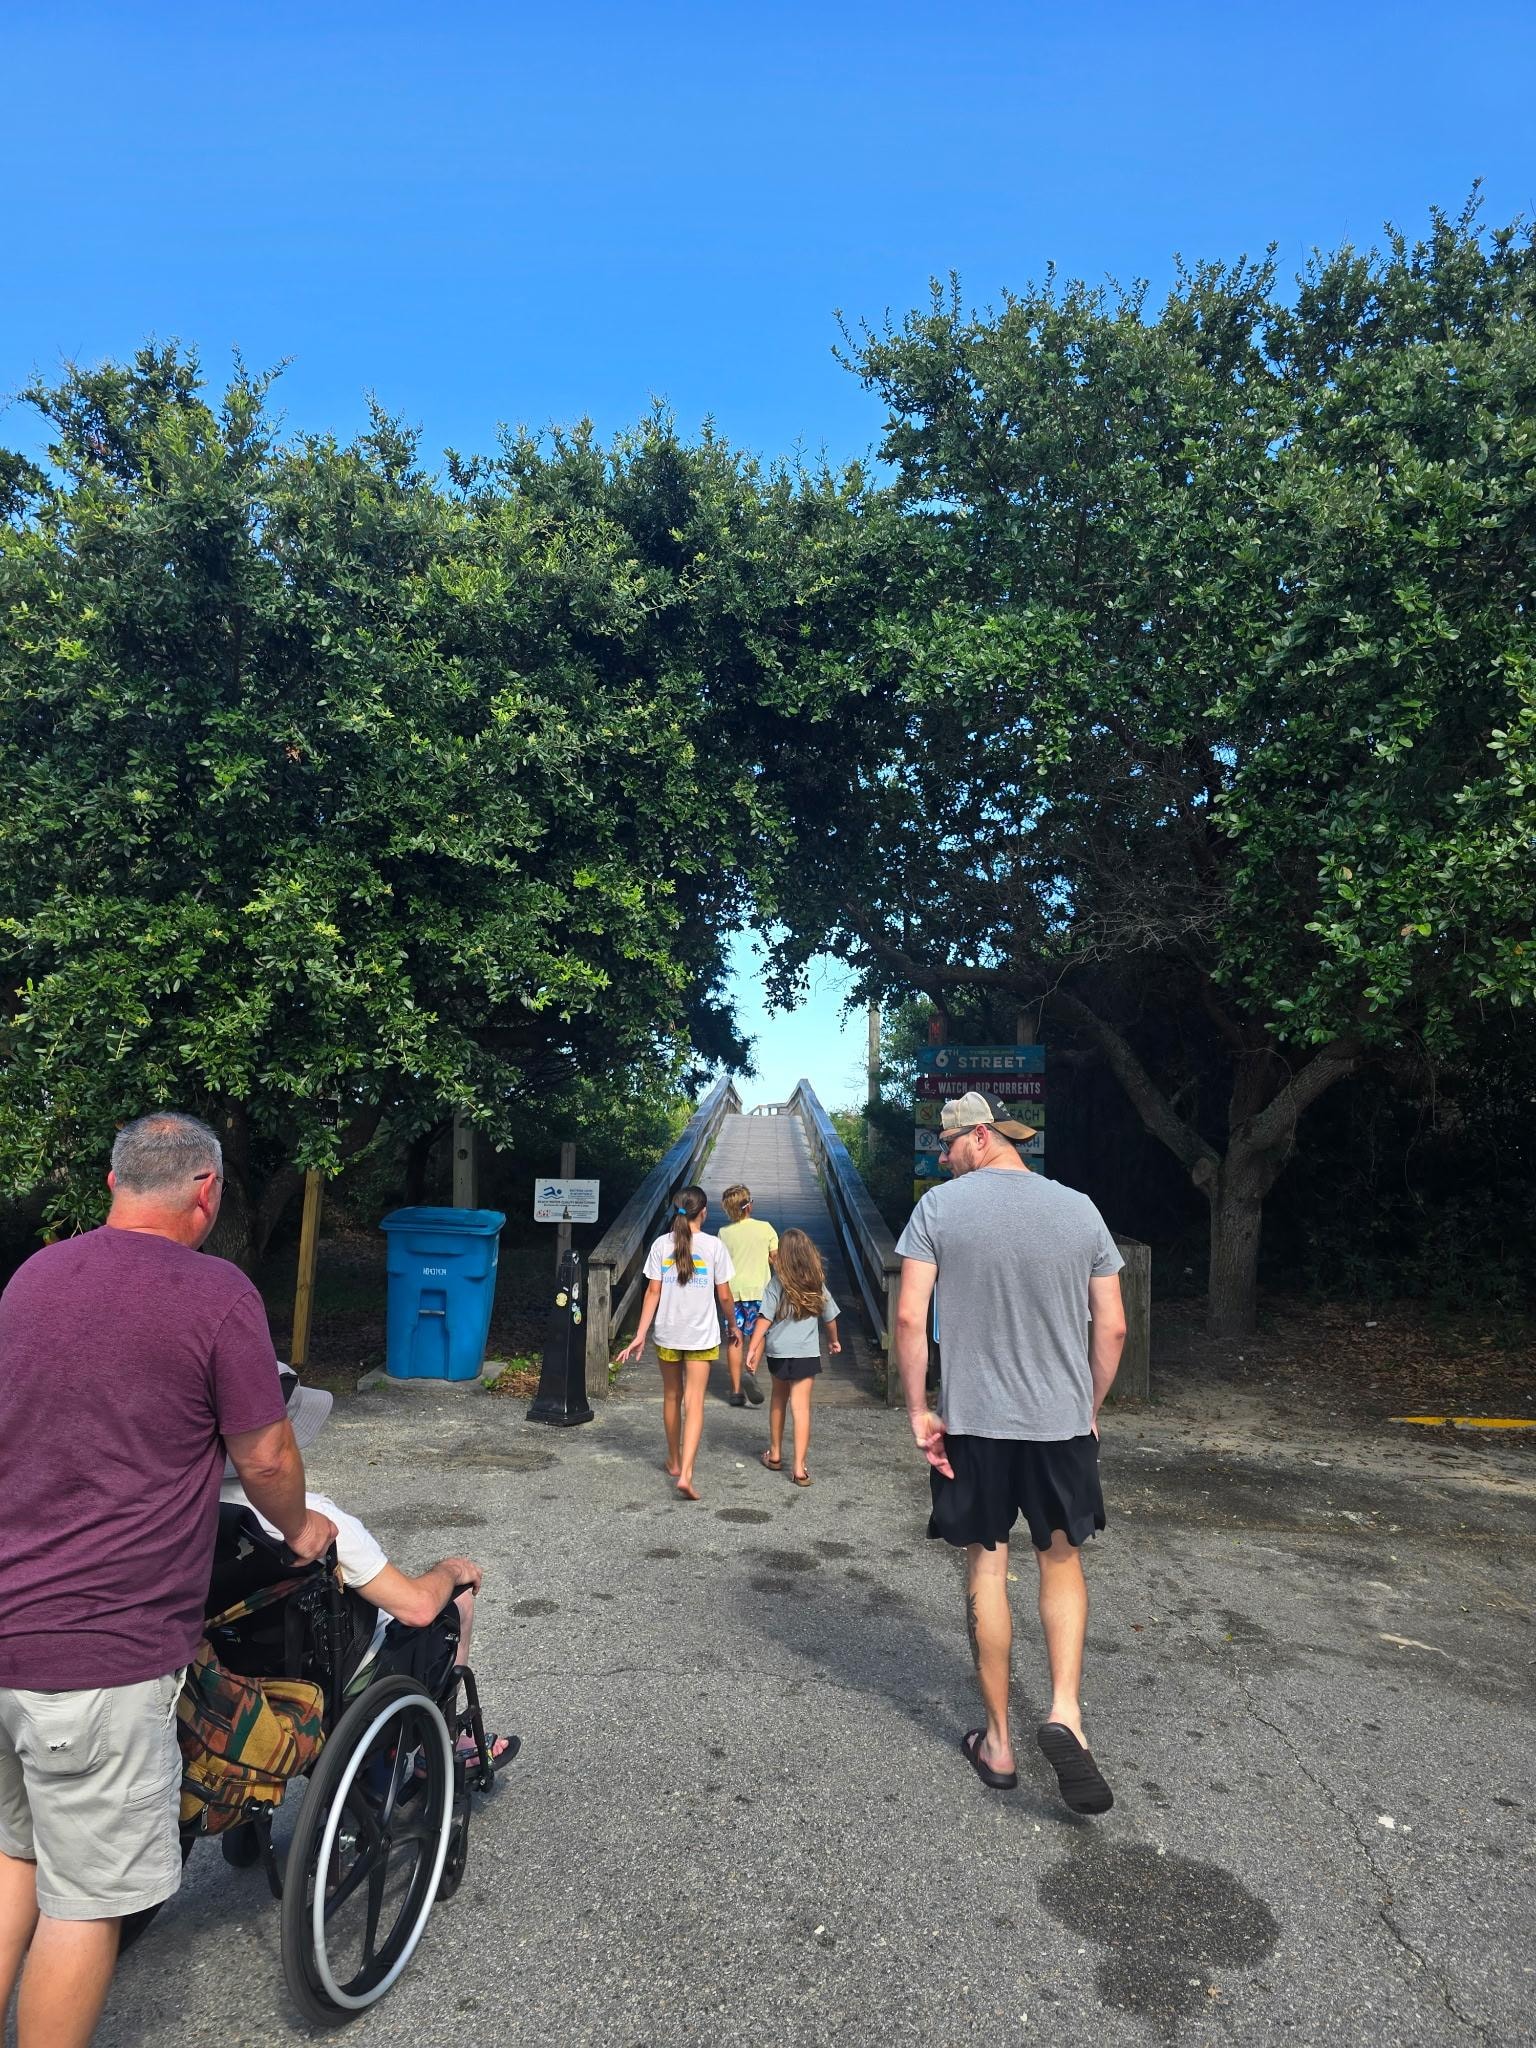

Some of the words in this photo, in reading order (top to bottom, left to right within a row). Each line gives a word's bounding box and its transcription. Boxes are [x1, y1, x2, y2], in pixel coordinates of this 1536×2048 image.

[958, 1056, 1026, 1068] STREET
[938, 1082, 968, 1094] WATCH
[993, 1082, 1041, 1094] CURRENTS
[1010, 1108, 1040, 1120] EACH
